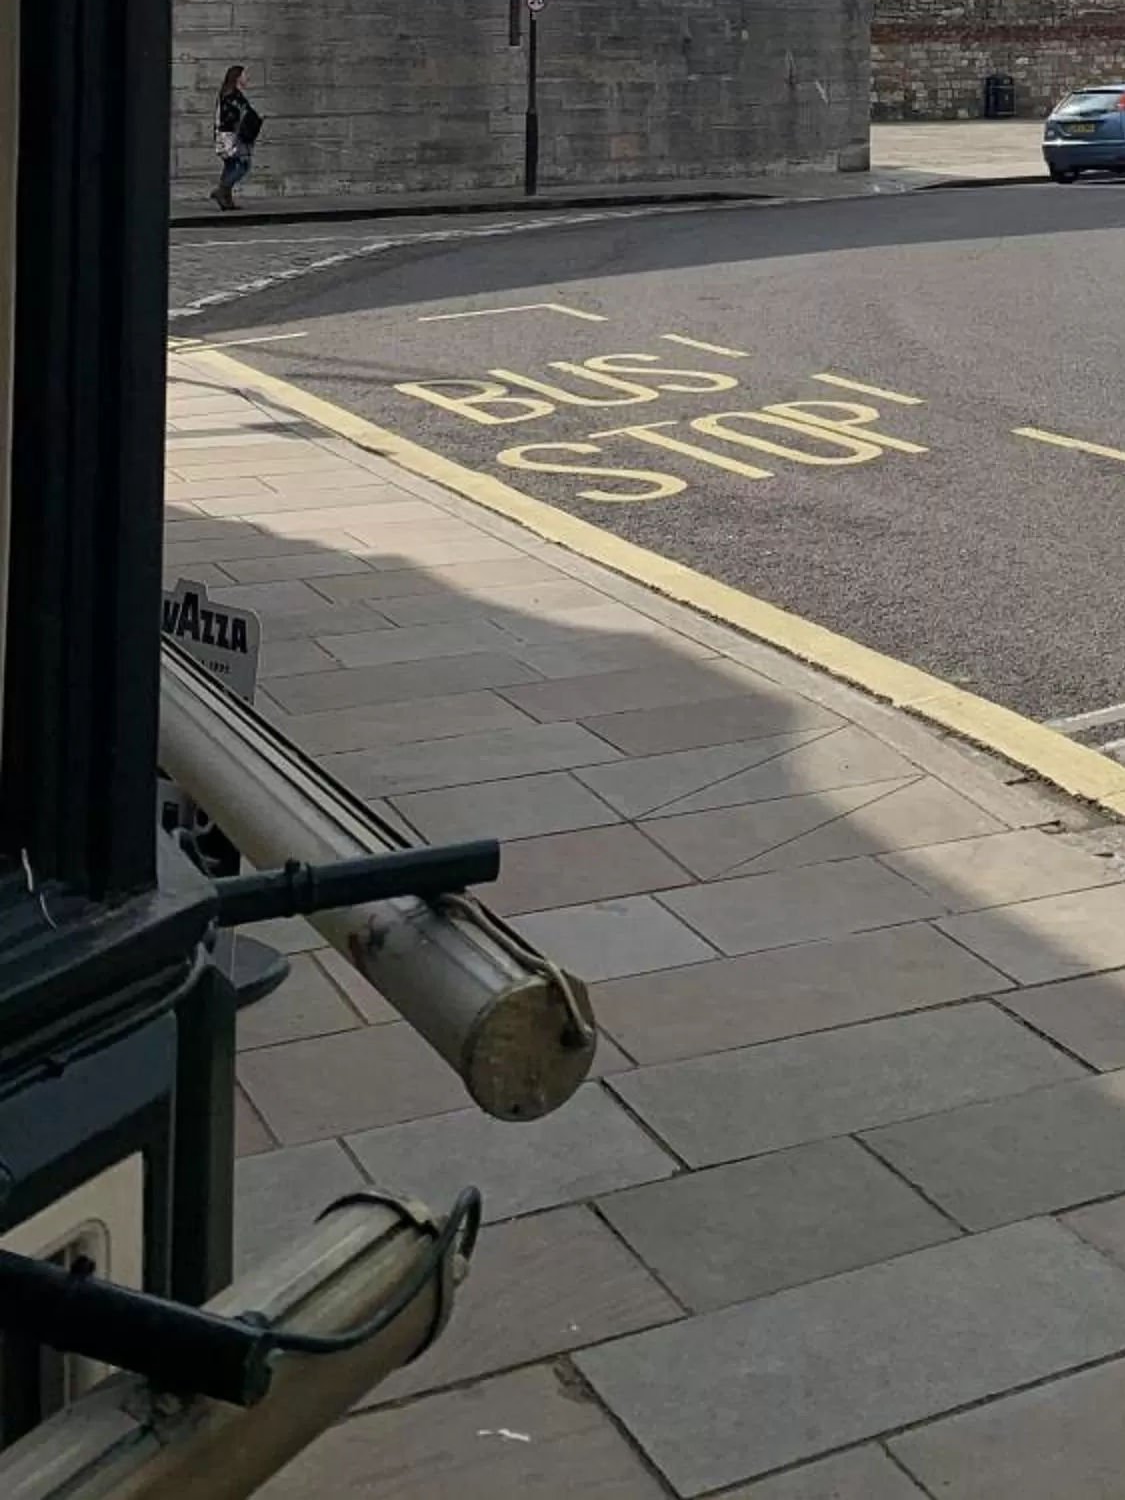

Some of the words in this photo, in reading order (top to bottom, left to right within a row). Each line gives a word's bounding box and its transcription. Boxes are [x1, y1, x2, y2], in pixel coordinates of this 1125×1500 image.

[394, 353, 738, 425] BUS
[497, 401, 929, 501] STOP
[163, 591, 248, 654] VAZZA
